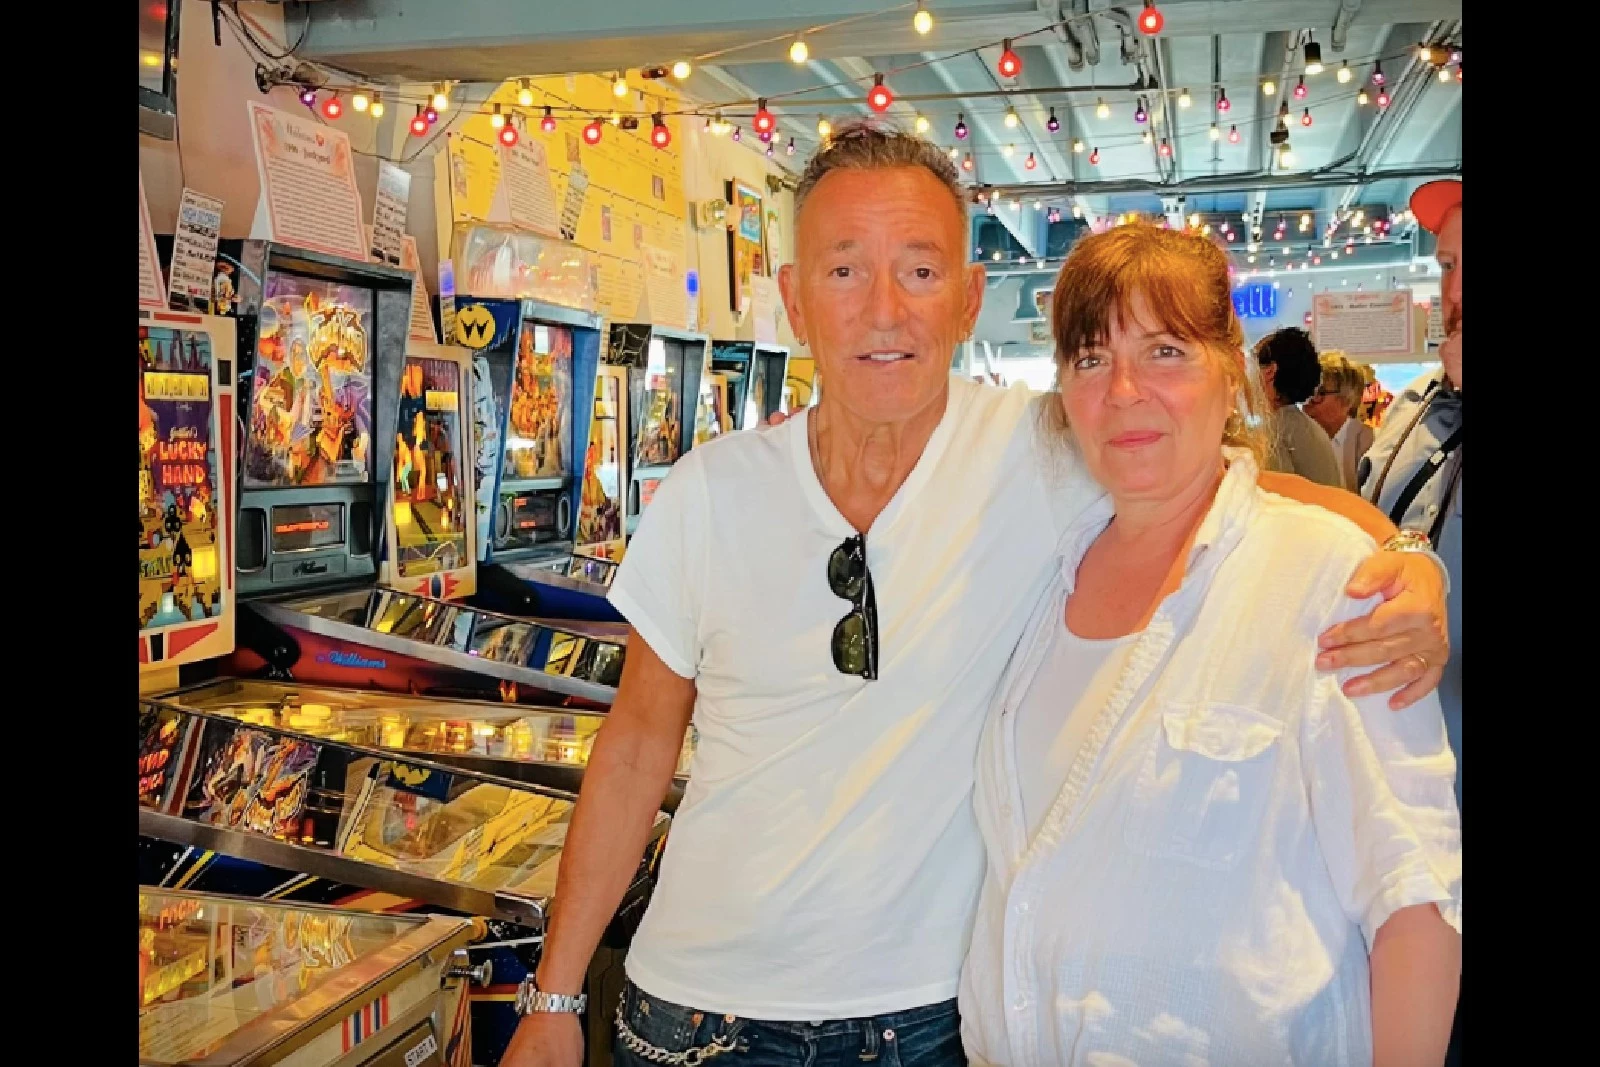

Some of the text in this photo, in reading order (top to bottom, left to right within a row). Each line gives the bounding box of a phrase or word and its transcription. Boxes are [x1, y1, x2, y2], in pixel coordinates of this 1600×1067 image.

[160, 441, 206, 460] LUCKY
[162, 464, 206, 484] HAND
[329, 650, 387, 669] Williams
